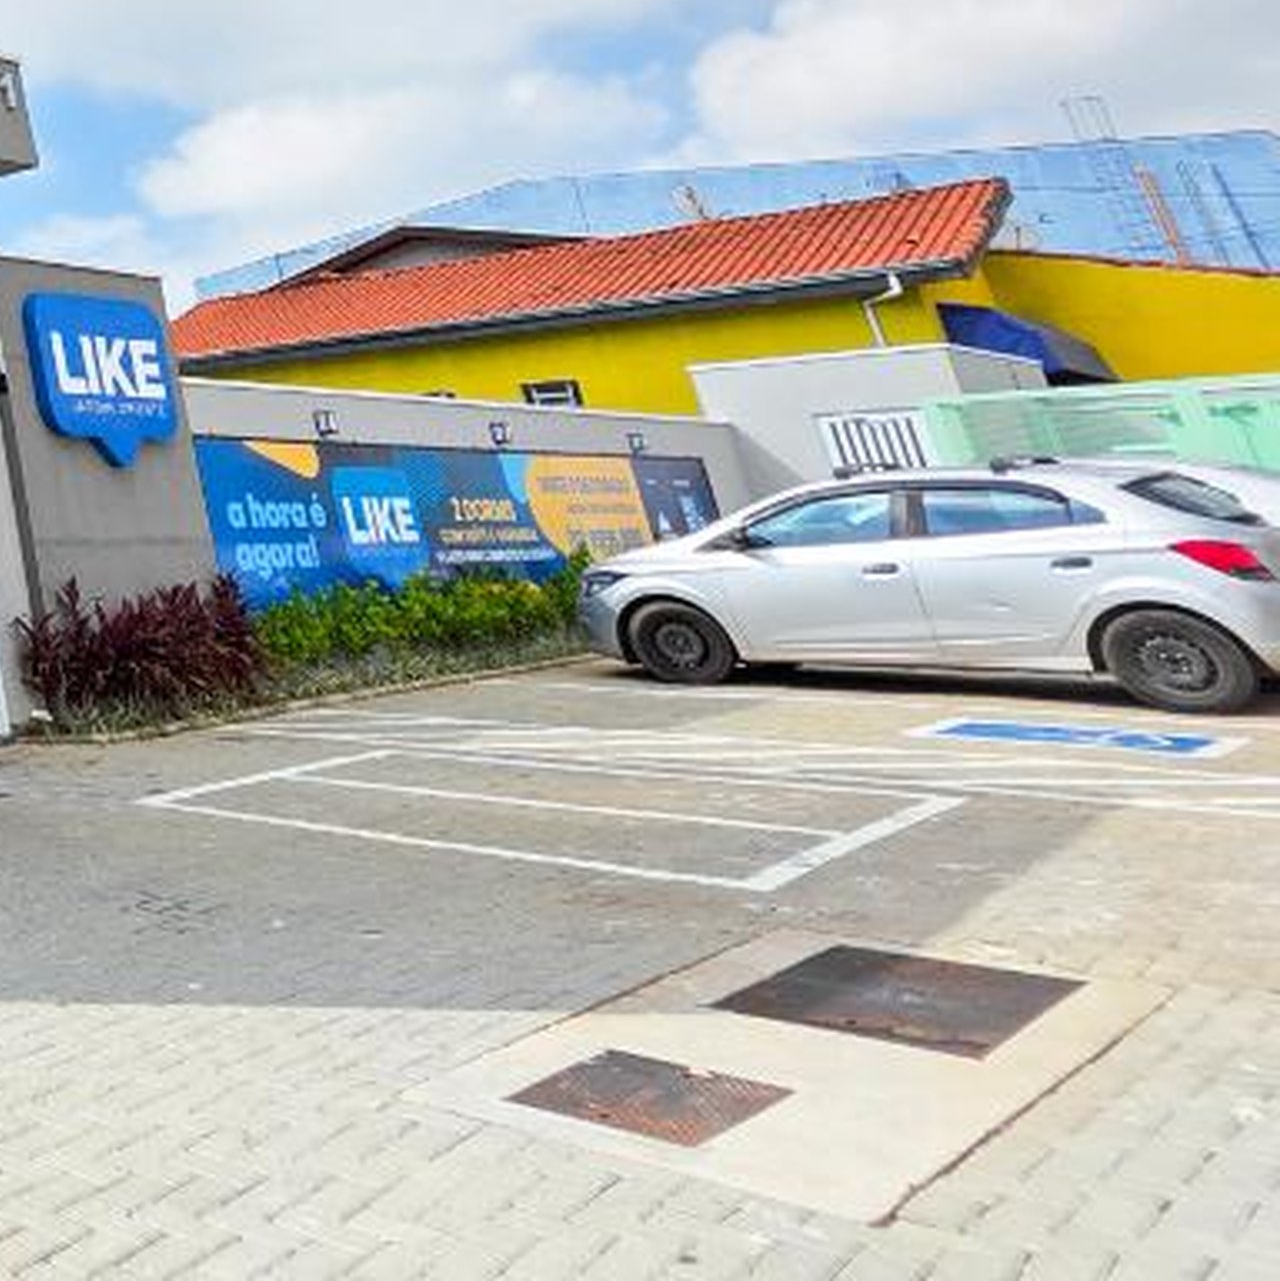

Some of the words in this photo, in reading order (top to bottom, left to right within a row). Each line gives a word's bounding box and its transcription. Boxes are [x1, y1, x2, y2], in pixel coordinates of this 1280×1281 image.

[49, 330, 167, 401] LIKE
[226, 501, 246, 528] a
[246, 492, 309, 529] hora
[342, 496, 420, 546] LIKE
[235, 533, 321, 581] agora!
